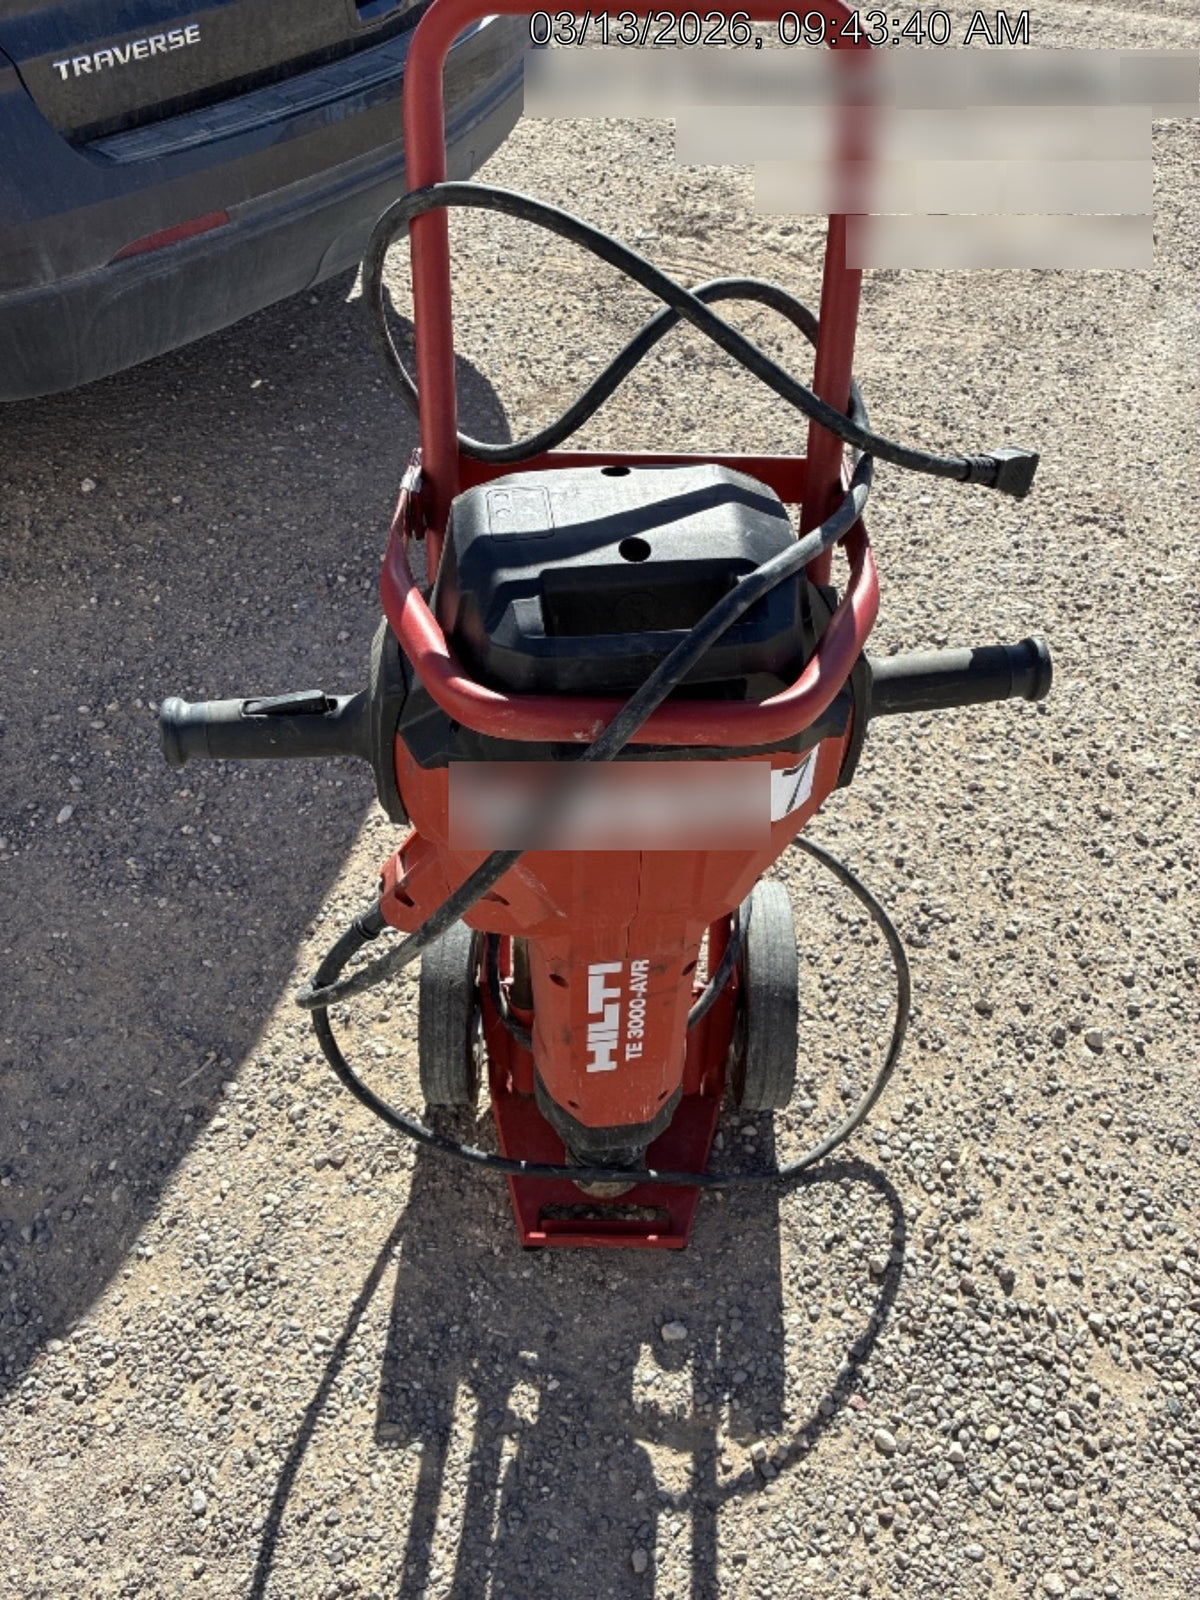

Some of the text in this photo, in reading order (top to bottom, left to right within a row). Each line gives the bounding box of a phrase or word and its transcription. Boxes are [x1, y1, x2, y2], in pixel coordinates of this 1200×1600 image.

[53, 24, 201, 80] TRAVERSE
[586, 961, 622, 1073] HILTI
[625, 959, 650, 1062] TE 3000-AVR
